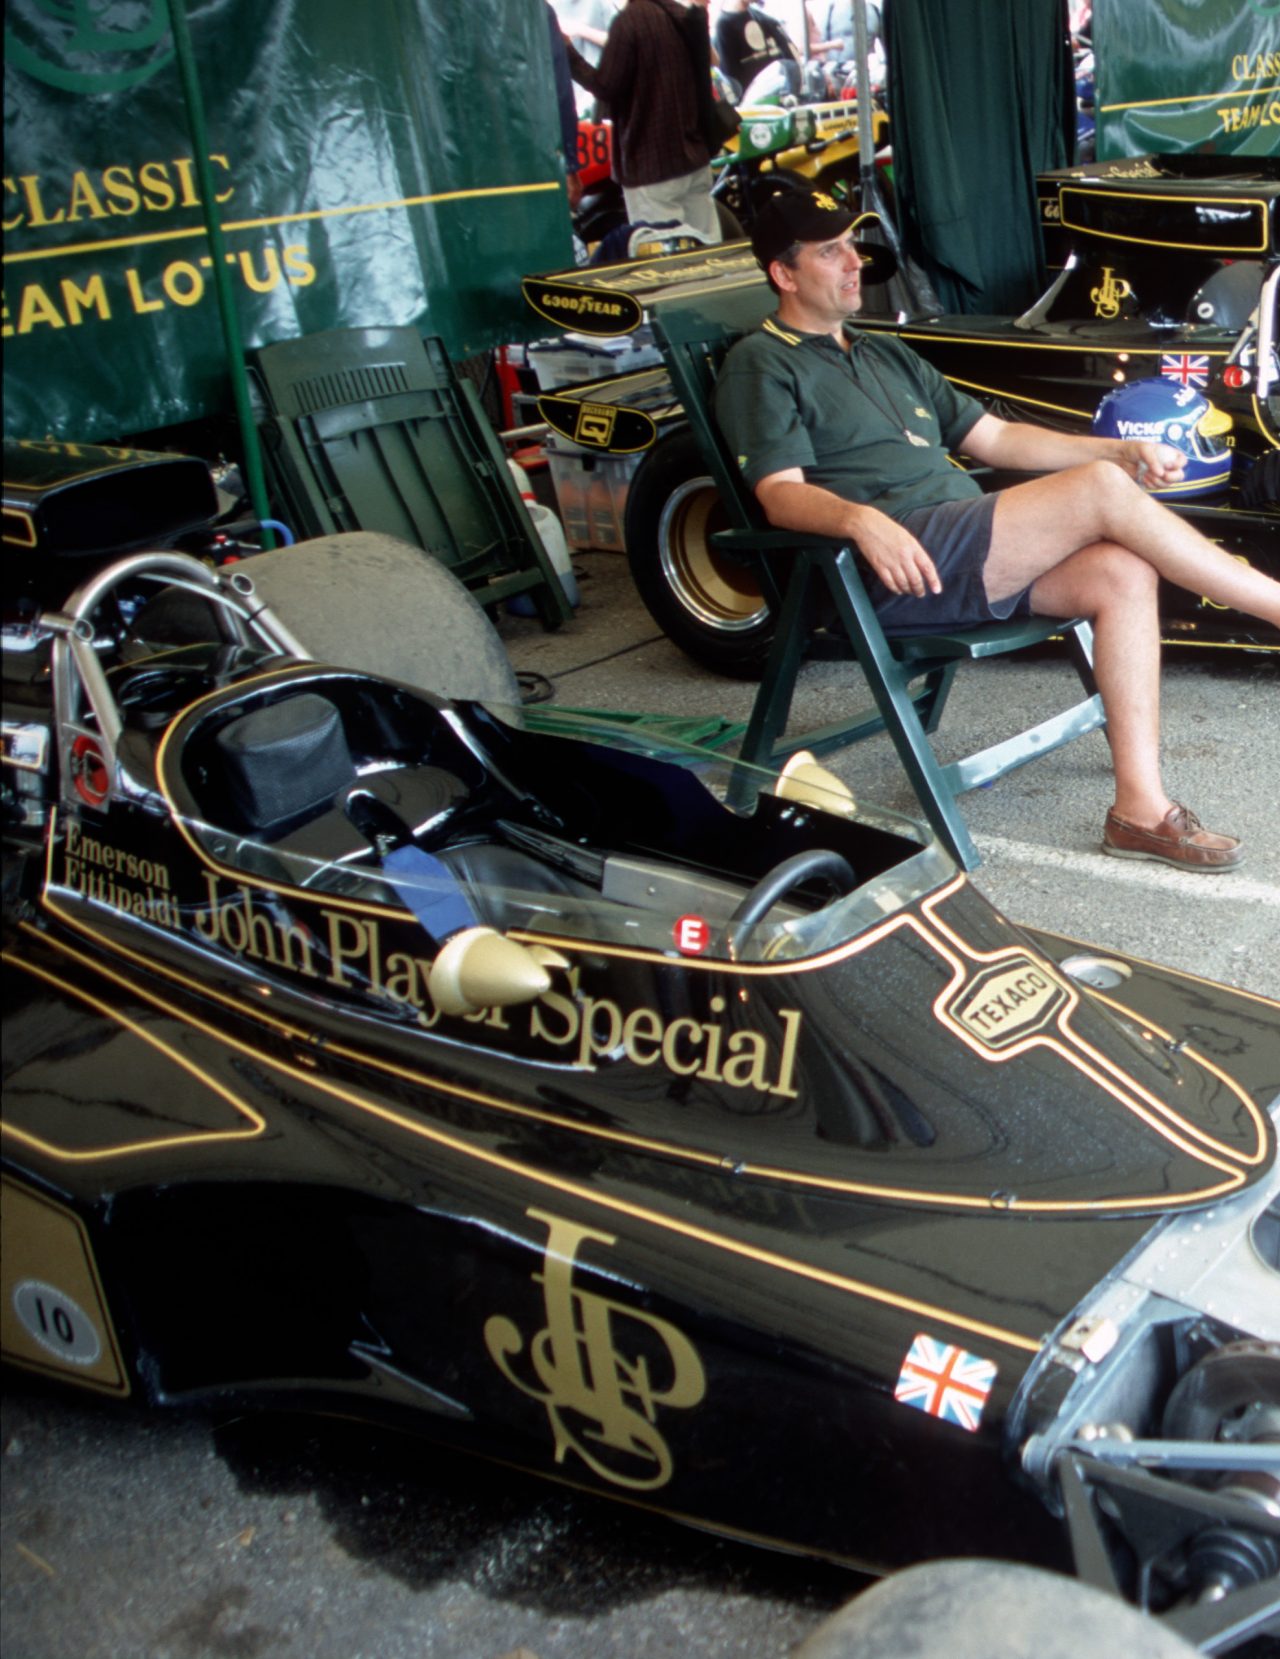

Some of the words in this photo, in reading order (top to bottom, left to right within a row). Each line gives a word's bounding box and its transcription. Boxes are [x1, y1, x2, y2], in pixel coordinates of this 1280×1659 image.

[1217, 104, 1261, 133] TEAM
[542, 294, 623, 316] GOODYEAR
[1117, 420, 1165, 436] VICKS
[65, 819, 170, 890] Emerson
[63, 856, 182, 930] Fittipaldi
[681, 919, 702, 950] E
[195, 870, 319, 977] John
[320, 910, 511, 1031] Pla
[530, 966, 801, 1099] Special
[968, 972, 1048, 1031] TEXACO
[35, 1296, 75, 1345] 10
